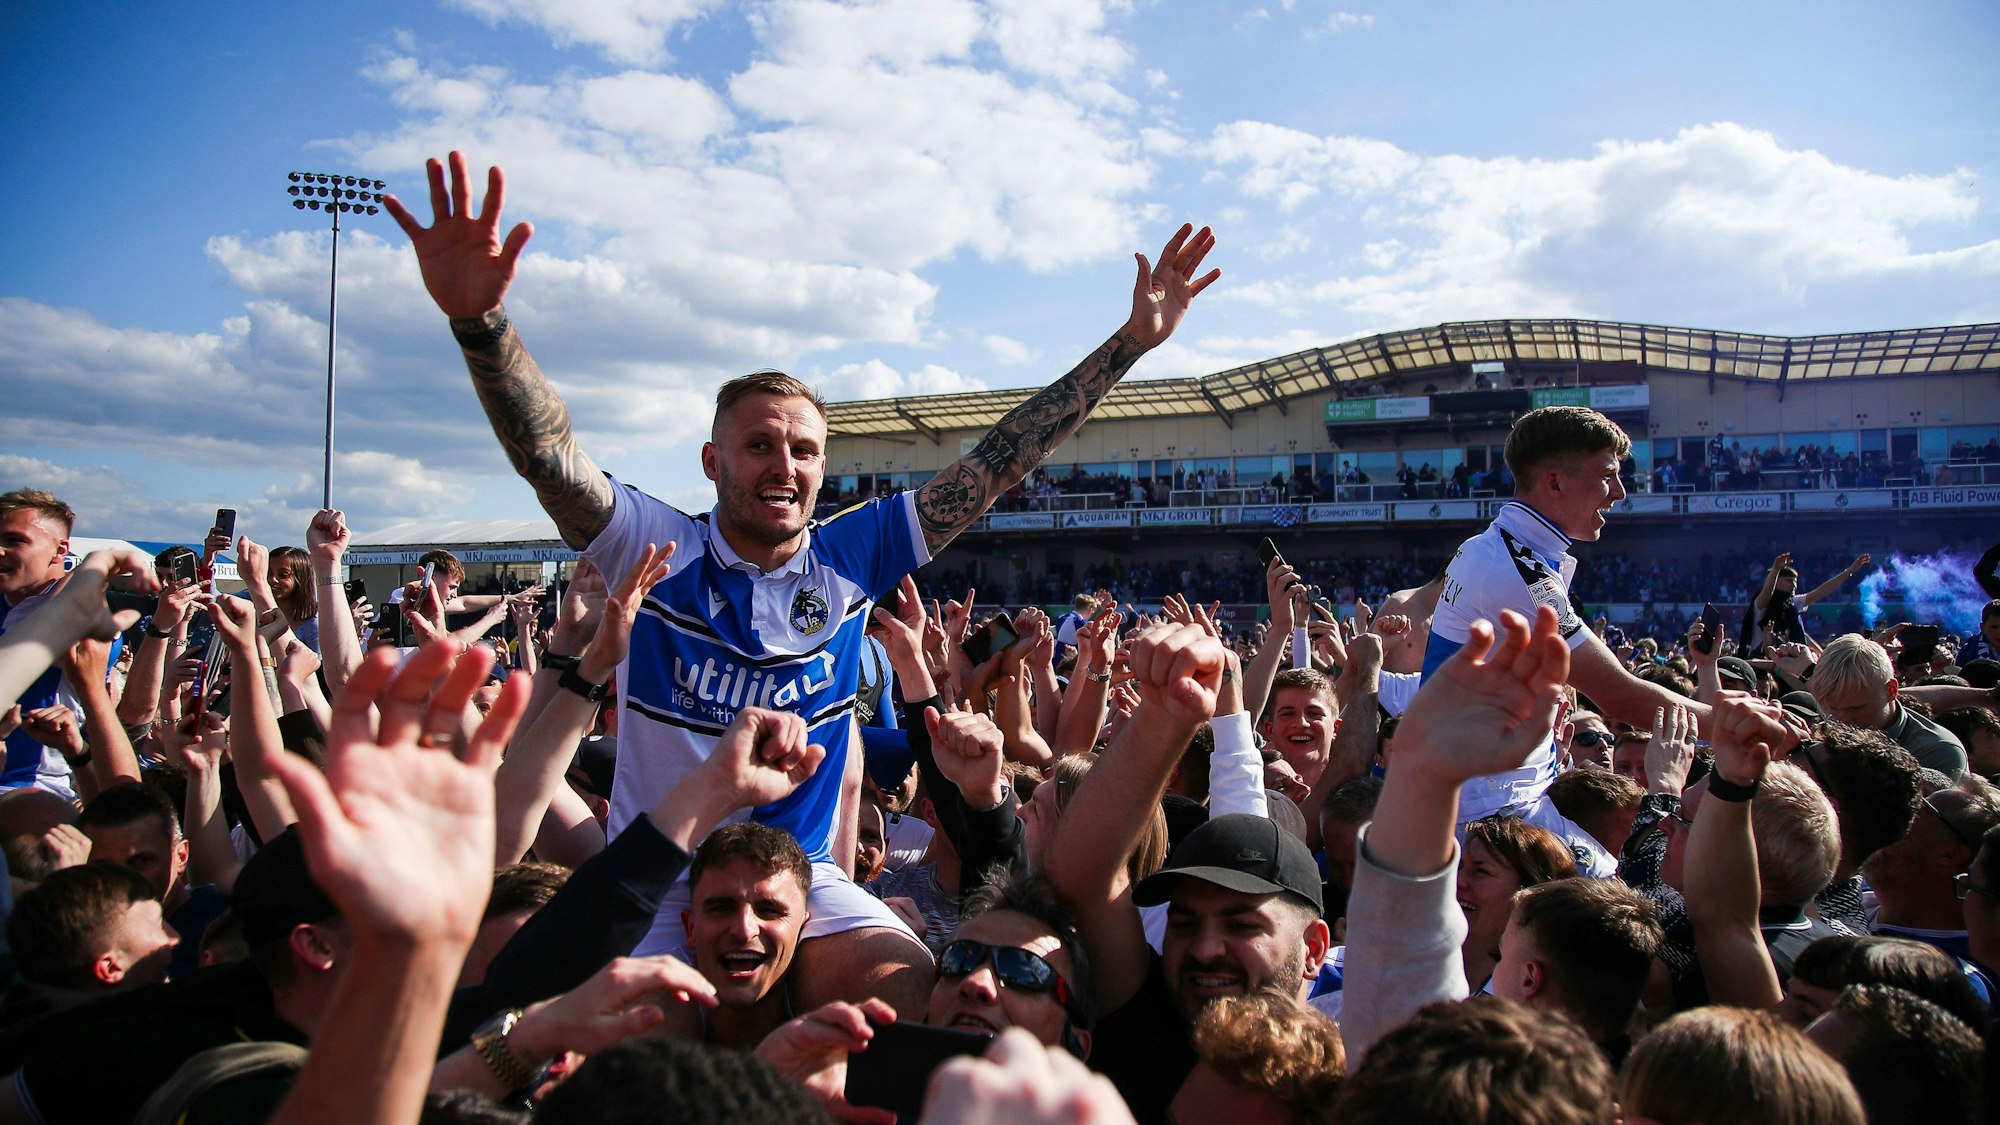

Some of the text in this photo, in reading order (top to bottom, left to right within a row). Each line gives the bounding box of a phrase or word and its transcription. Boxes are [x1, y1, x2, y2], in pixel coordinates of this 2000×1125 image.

[1910, 492, 1929, 504] AB
[1933, 490, 1963, 504] Fluid
[1714, 496, 1773, 512] Gregor
[1078, 512, 1128, 523] AQUARIAN
[1143, 510, 1210, 522] MKJ GROUP
[1320, 507, 1382, 519] COMMUNITY TRUST
[342, 554, 358, 564] MKJ
[401, 553, 418, 563] MKJ
[465, 551, 484, 562] MKJ
[485, 554, 507, 562] GROUP
[533, 550, 552, 562] MKJ
[671, 687, 695, 710] life
